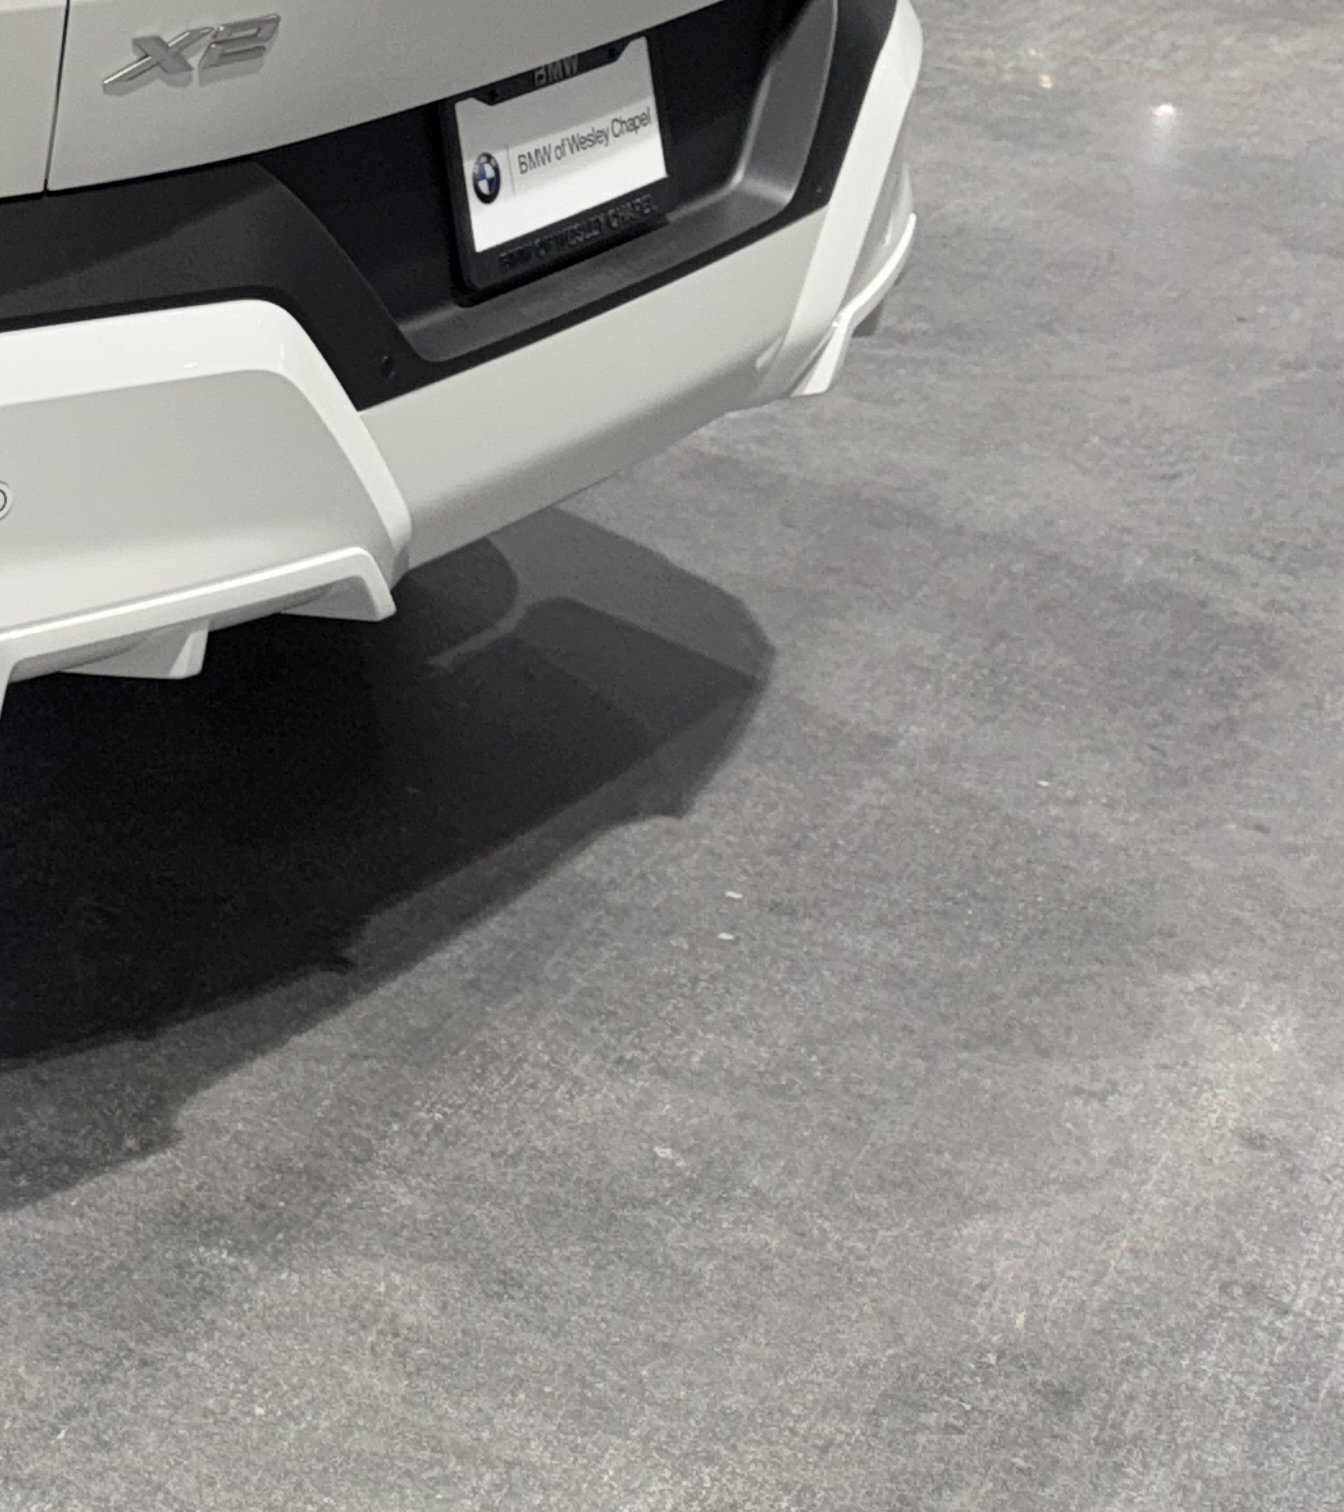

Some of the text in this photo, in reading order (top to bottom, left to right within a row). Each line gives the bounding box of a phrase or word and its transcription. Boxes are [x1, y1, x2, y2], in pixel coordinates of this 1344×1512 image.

[102, 13, 281, 88] X2
[534, 55, 579, 85] BMW
[517, 106, 652, 174] BMW of Wesley Chapel
